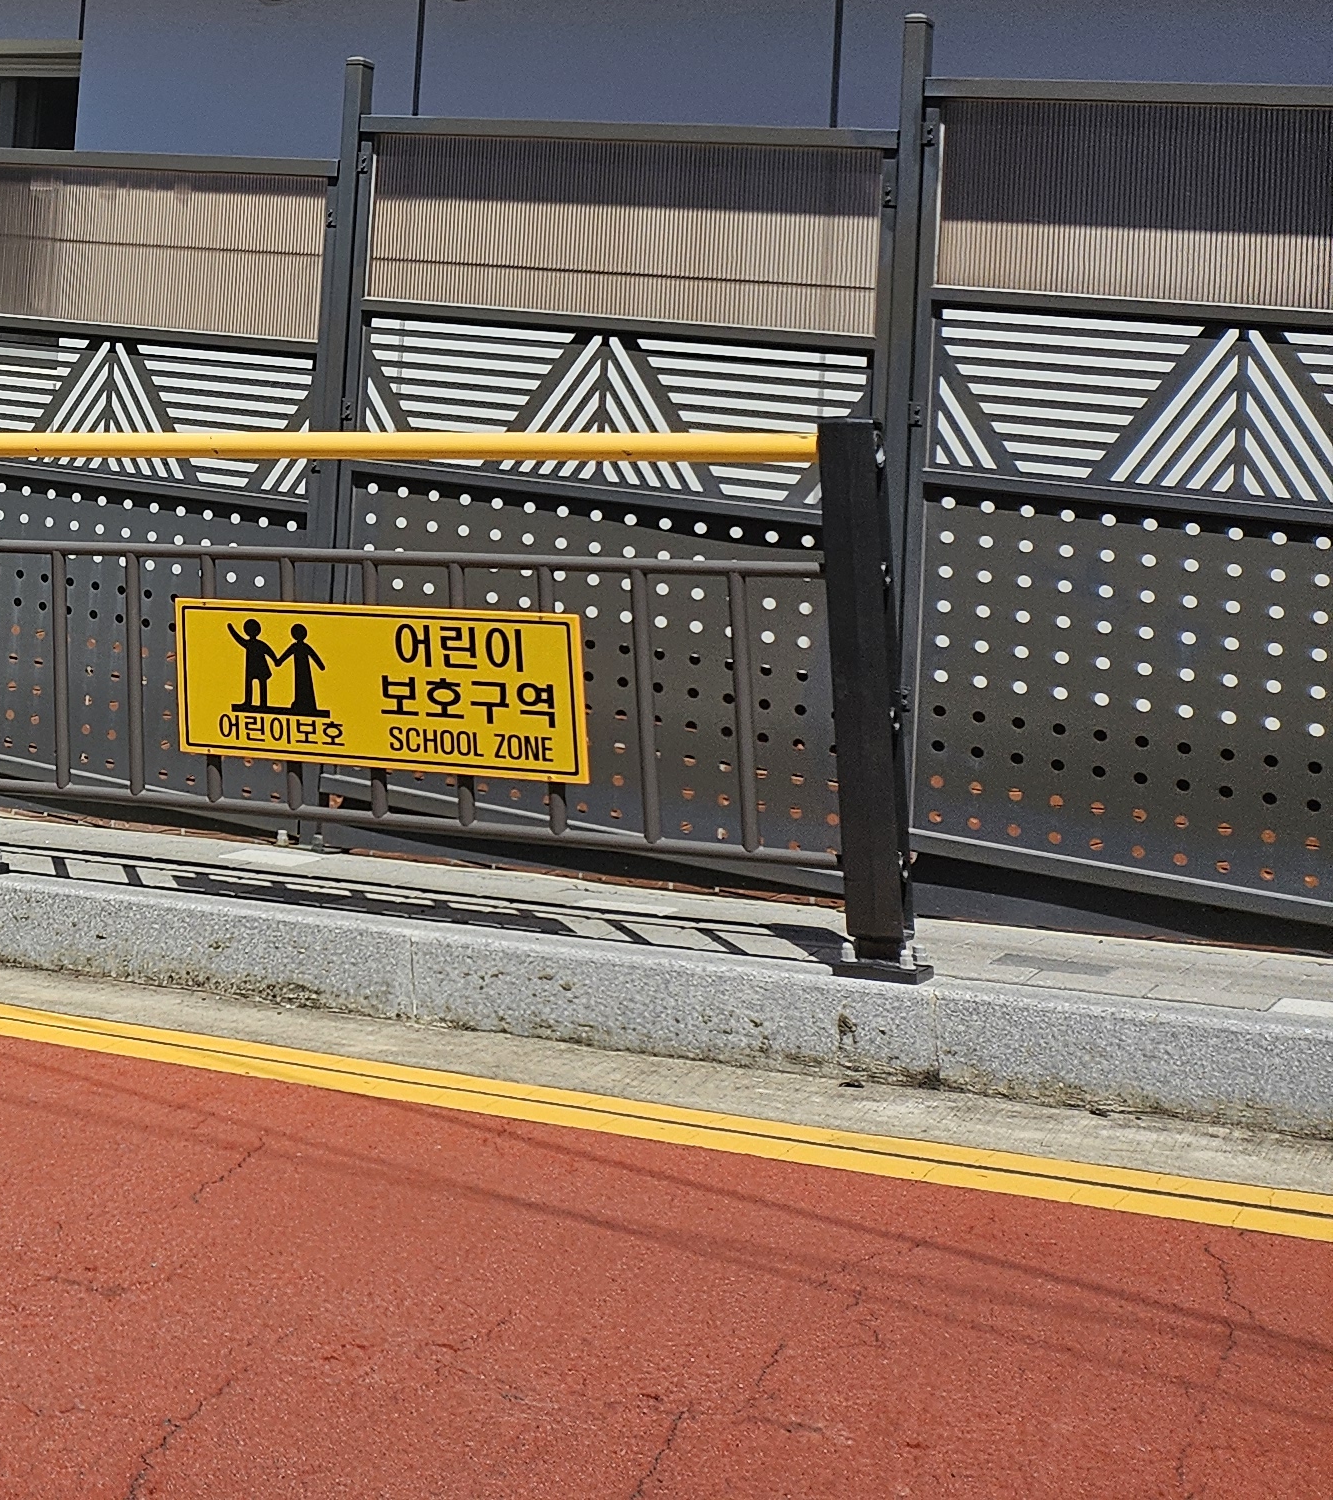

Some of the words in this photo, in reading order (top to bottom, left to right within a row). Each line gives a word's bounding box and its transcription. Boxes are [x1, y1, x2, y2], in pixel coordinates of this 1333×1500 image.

[394, 622, 525, 673] 어린이
[380, 674, 557, 729] 보호구역
[218, 711, 346, 747] 어린이보호
[388, 726, 485, 758] SCHOOL
[493, 733, 554, 763] ZONE
